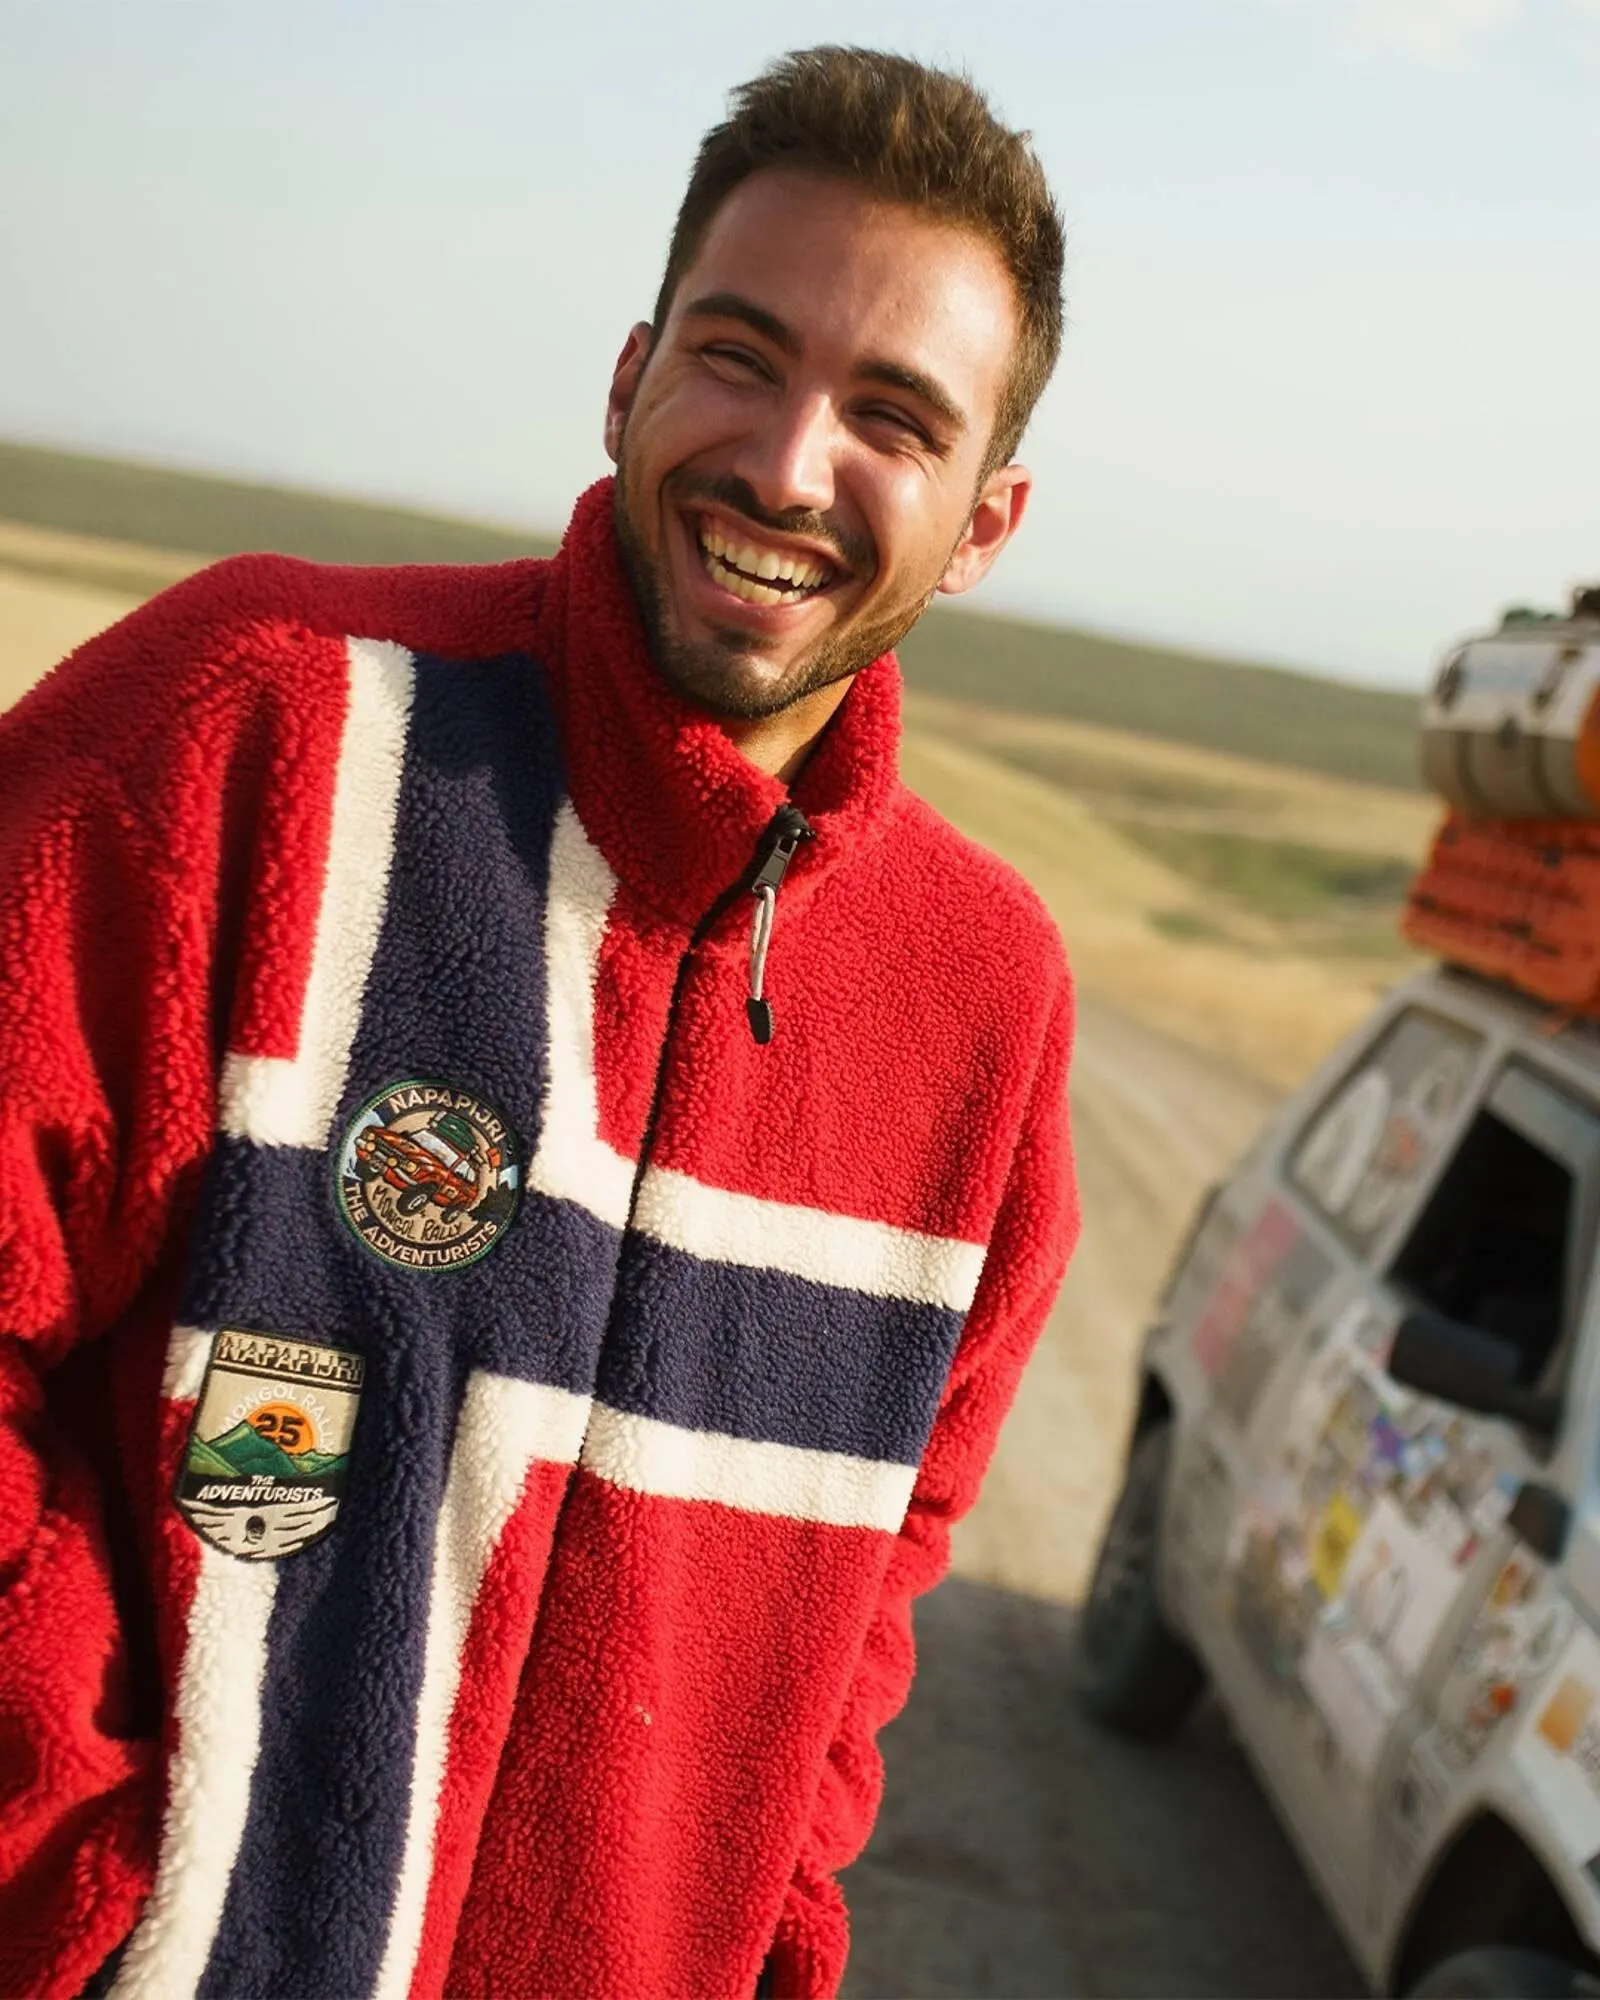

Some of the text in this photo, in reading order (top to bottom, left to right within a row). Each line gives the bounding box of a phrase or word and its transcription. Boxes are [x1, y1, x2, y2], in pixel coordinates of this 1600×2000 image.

[389, 1088, 506, 1143] NAPAPIJRI
[345, 1182, 498, 1265] THE ADVENTURISTS
[372, 1185, 464, 1242] MONGOL RALLY
[219, 1336, 361, 1382] NAPAPIJRI
[221, 1383, 338, 1453] MONGOL RALLY
[256, 1412, 305, 1447] 25
[197, 1484, 324, 1502] ADVENTURISTS
[251, 1475, 275, 1486] THE
